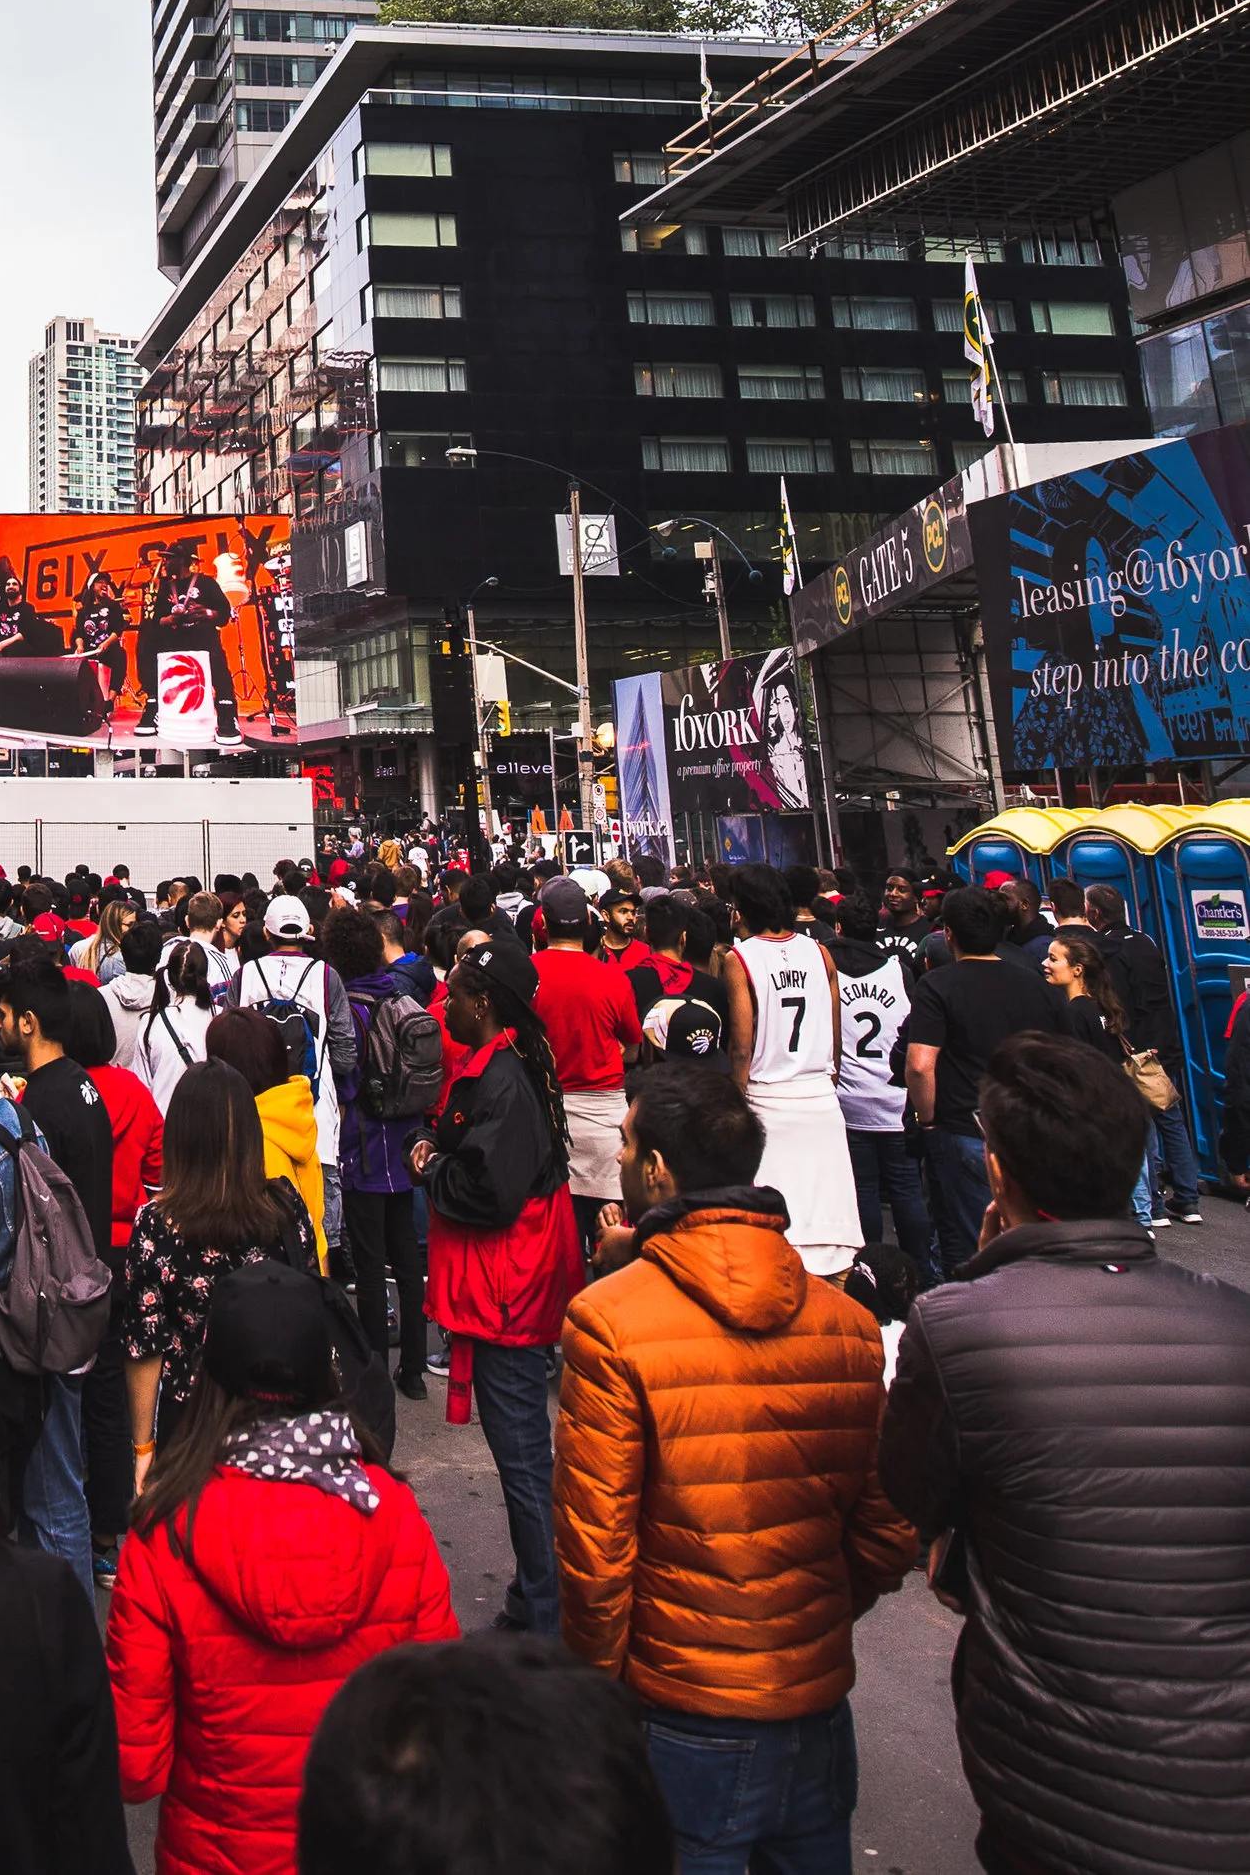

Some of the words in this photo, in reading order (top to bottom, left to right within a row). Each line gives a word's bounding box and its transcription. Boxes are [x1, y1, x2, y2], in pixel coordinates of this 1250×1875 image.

[926, 519, 943, 553] PCL
[859, 536, 901, 607] GATE
[901, 526, 914, 583] 5
[1017, 524, 1250, 618] leasing@16yor
[836, 582, 850, 607] PCL
[1030, 660, 1083, 709] step
[1092, 644, 1149, 689] into
[1159, 628, 1209, 681] the
[672, 693, 760, 752] 16YORK
[676, 766, 682, 777] a
[682, 760, 711, 782] premium
[712, 758, 731, 778] office
[731, 759, 762, 778] property
[1196, 905, 1242, 919] Chantler's
[770, 970, 807, 991] LOWRY
[840, 982, 896, 1009] LEONARD
[781, 996, 806, 1052] 7
[853, 1011, 883, 1058] 2
